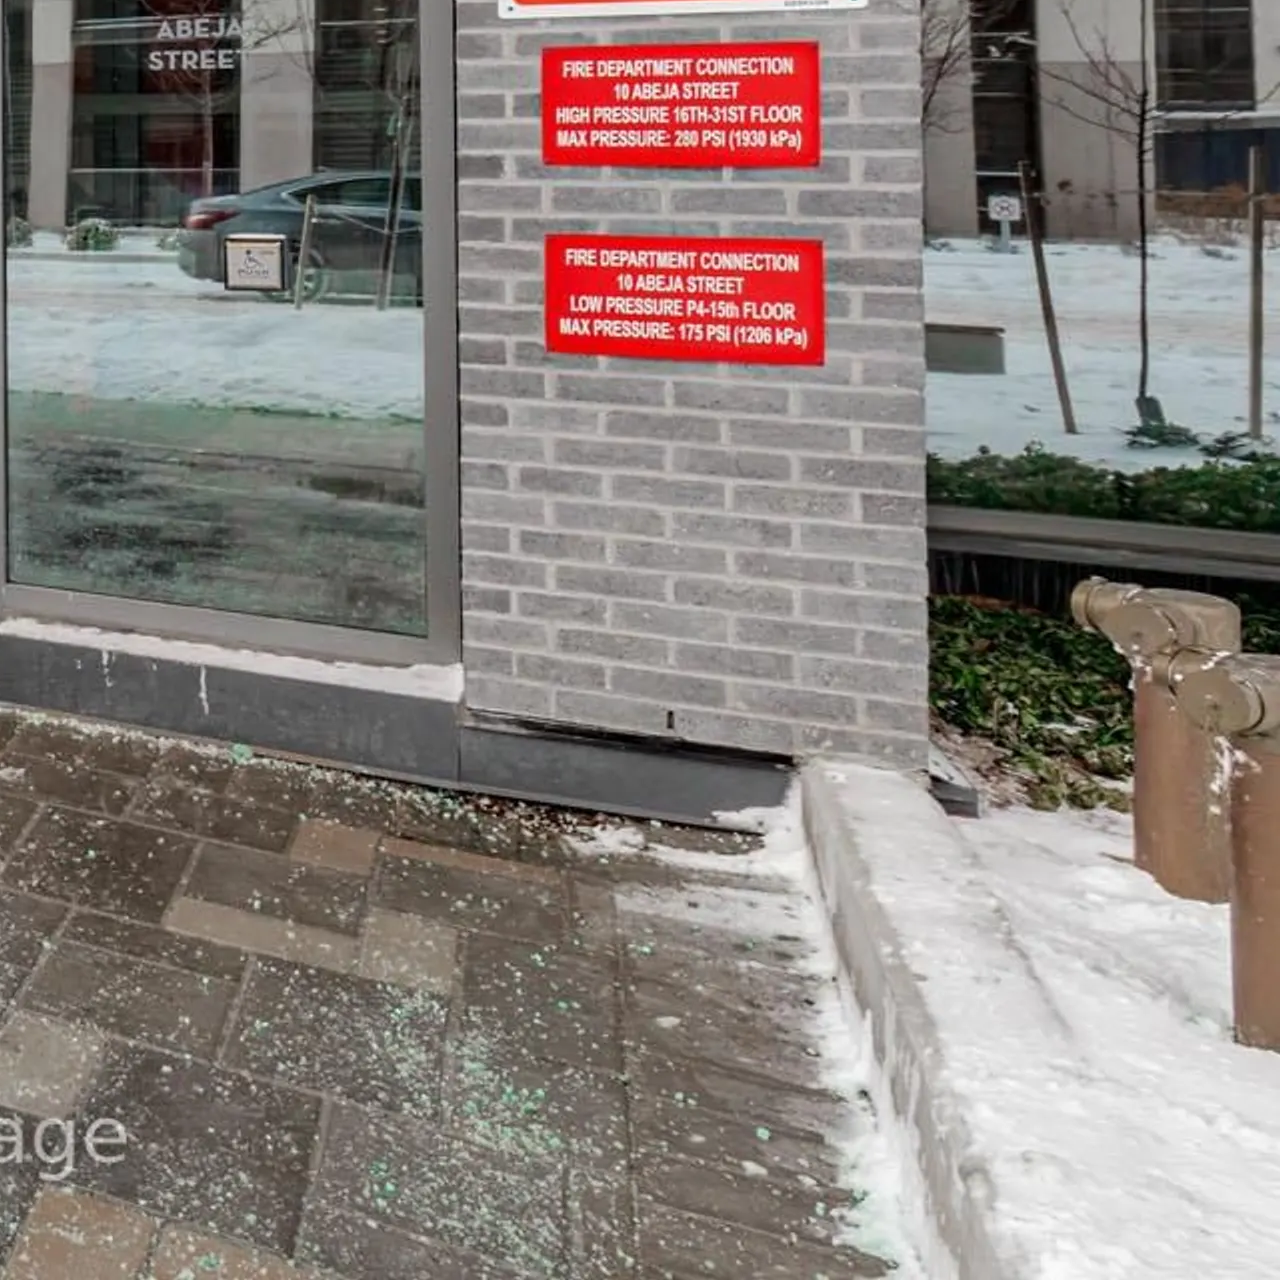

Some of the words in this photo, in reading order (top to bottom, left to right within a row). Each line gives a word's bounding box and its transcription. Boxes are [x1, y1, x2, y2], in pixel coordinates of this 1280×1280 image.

[157, 17, 246, 40] ABEJA
[562, 60, 595, 78] FIRE
[597, 58, 692, 77] DEPARTMENT
[696, 57, 794, 75] CONNECTION
[614, 83, 632, 100] 10
[632, 82, 679, 99] ABEJA
[682, 81, 740, 99] STREET
[556, 107, 589, 124] HIGH
[593, 106, 670, 124] PRESSURE
[673, 105, 746, 123] 16TH-31ST
[750, 105, 803, 122] FLOOR
[556, 130, 587, 147] MAX
[590, 130, 672, 147] PRESSURE:
[702, 130, 726, 148] PSI
[729, 130, 767, 151] (1930
[769, 130, 802, 151] kPa)
[565, 248, 597, 267] FIRE
[600, 249, 697, 269] DEPARTMENT
[700, 252, 800, 272] CONNECTION
[617, 274, 634, 291] 10
[636, 275, 684, 292] ABEJA
[687, 276, 744, 294] STREET
[570, 295, 602, 312] LOW
[605, 296, 685, 317] PRESSURE
[687, 299, 740, 319] P4-15th
[743, 302, 795, 320] FLOOR
[559, 318, 590, 335] MAX
[593, 319, 675, 340] PRESSURE:
[678, 323, 703, 341] 175
[706, 325, 730, 343] PSI
[733, 325, 772, 348] (1206
[775, 327, 808, 350] kPa)
